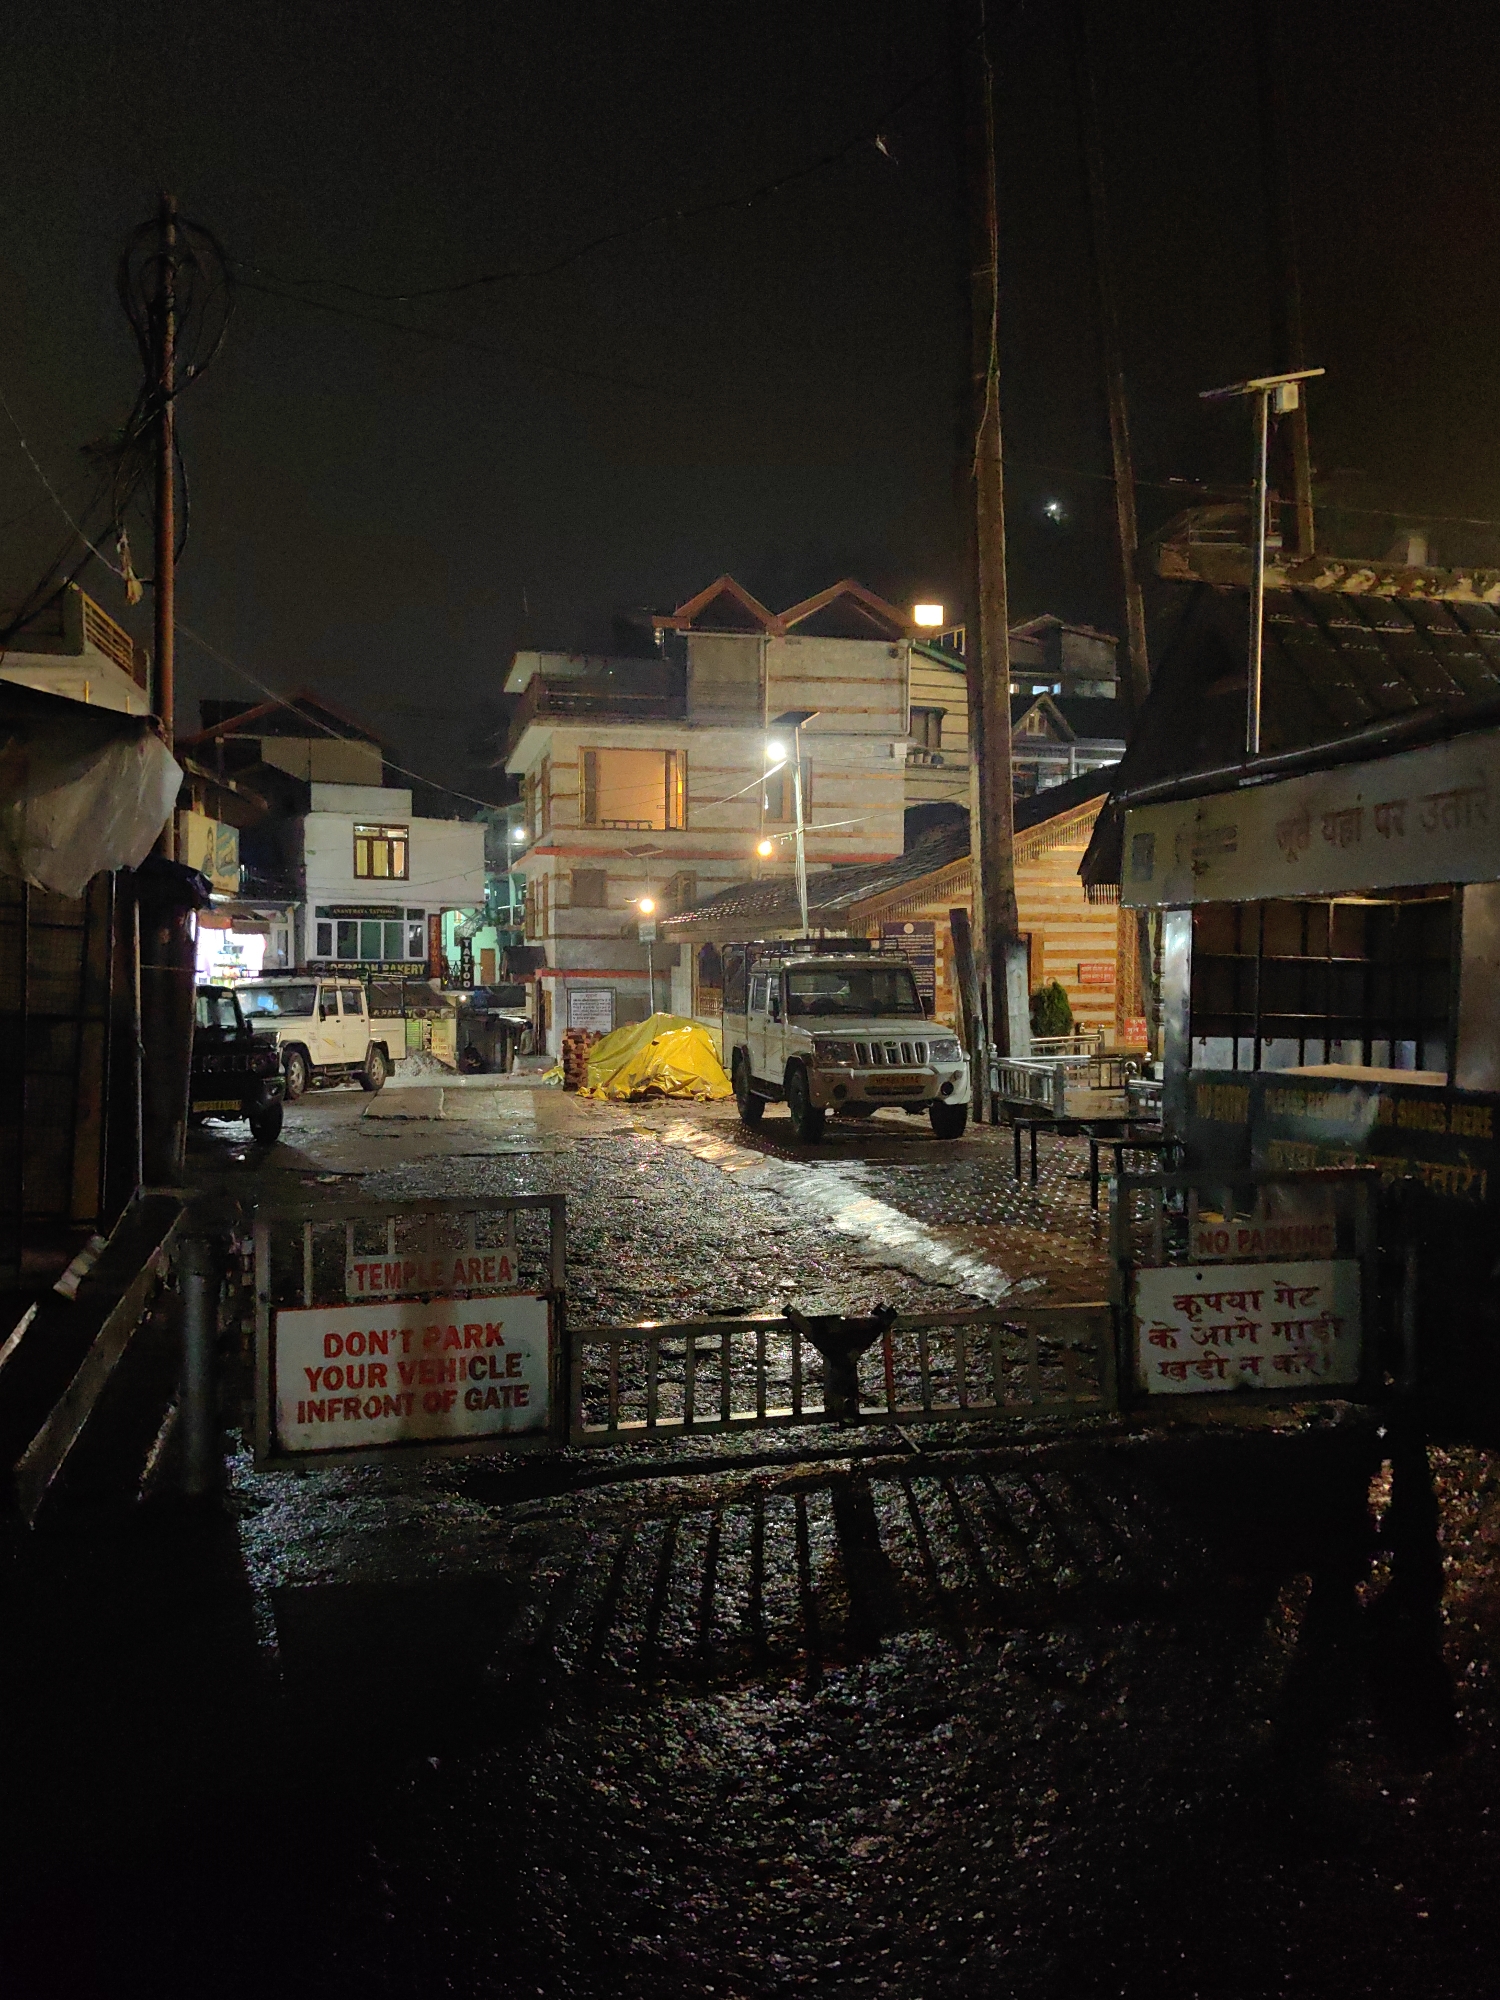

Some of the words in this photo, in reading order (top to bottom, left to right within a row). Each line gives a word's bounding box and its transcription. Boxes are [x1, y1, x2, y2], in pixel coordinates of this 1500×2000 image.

[1373, 799, 1409, 839] पर
[382, 963, 426, 976] BAKERY
[462, 939, 471, 988] TATTOO
[1197, 1230, 1230, 1253] NO
[1238, 1223, 1331, 1251] PARKING
[353, 1258, 445, 1291] TEMPLE
[452, 1254, 513, 1286] AREA
[1172, 1289, 1264, 1322] कृपया
[1273, 1280, 1320, 1309] गेट
[322, 1329, 411, 1358] DON'T
[421, 1321, 506, 1351] PARK
[1148, 1320, 1181, 1349] के
[1190, 1316, 1263, 1346] आगे
[304, 1362, 388, 1393] YOUR
[397, 1353, 523, 1387] VEHICLE
[1239, 1355, 1264, 1376] न
[296, 1392, 415, 1425] INFRONT
[421, 1389, 459, 1414] OF
[464, 1383, 530, 1411] GATE
